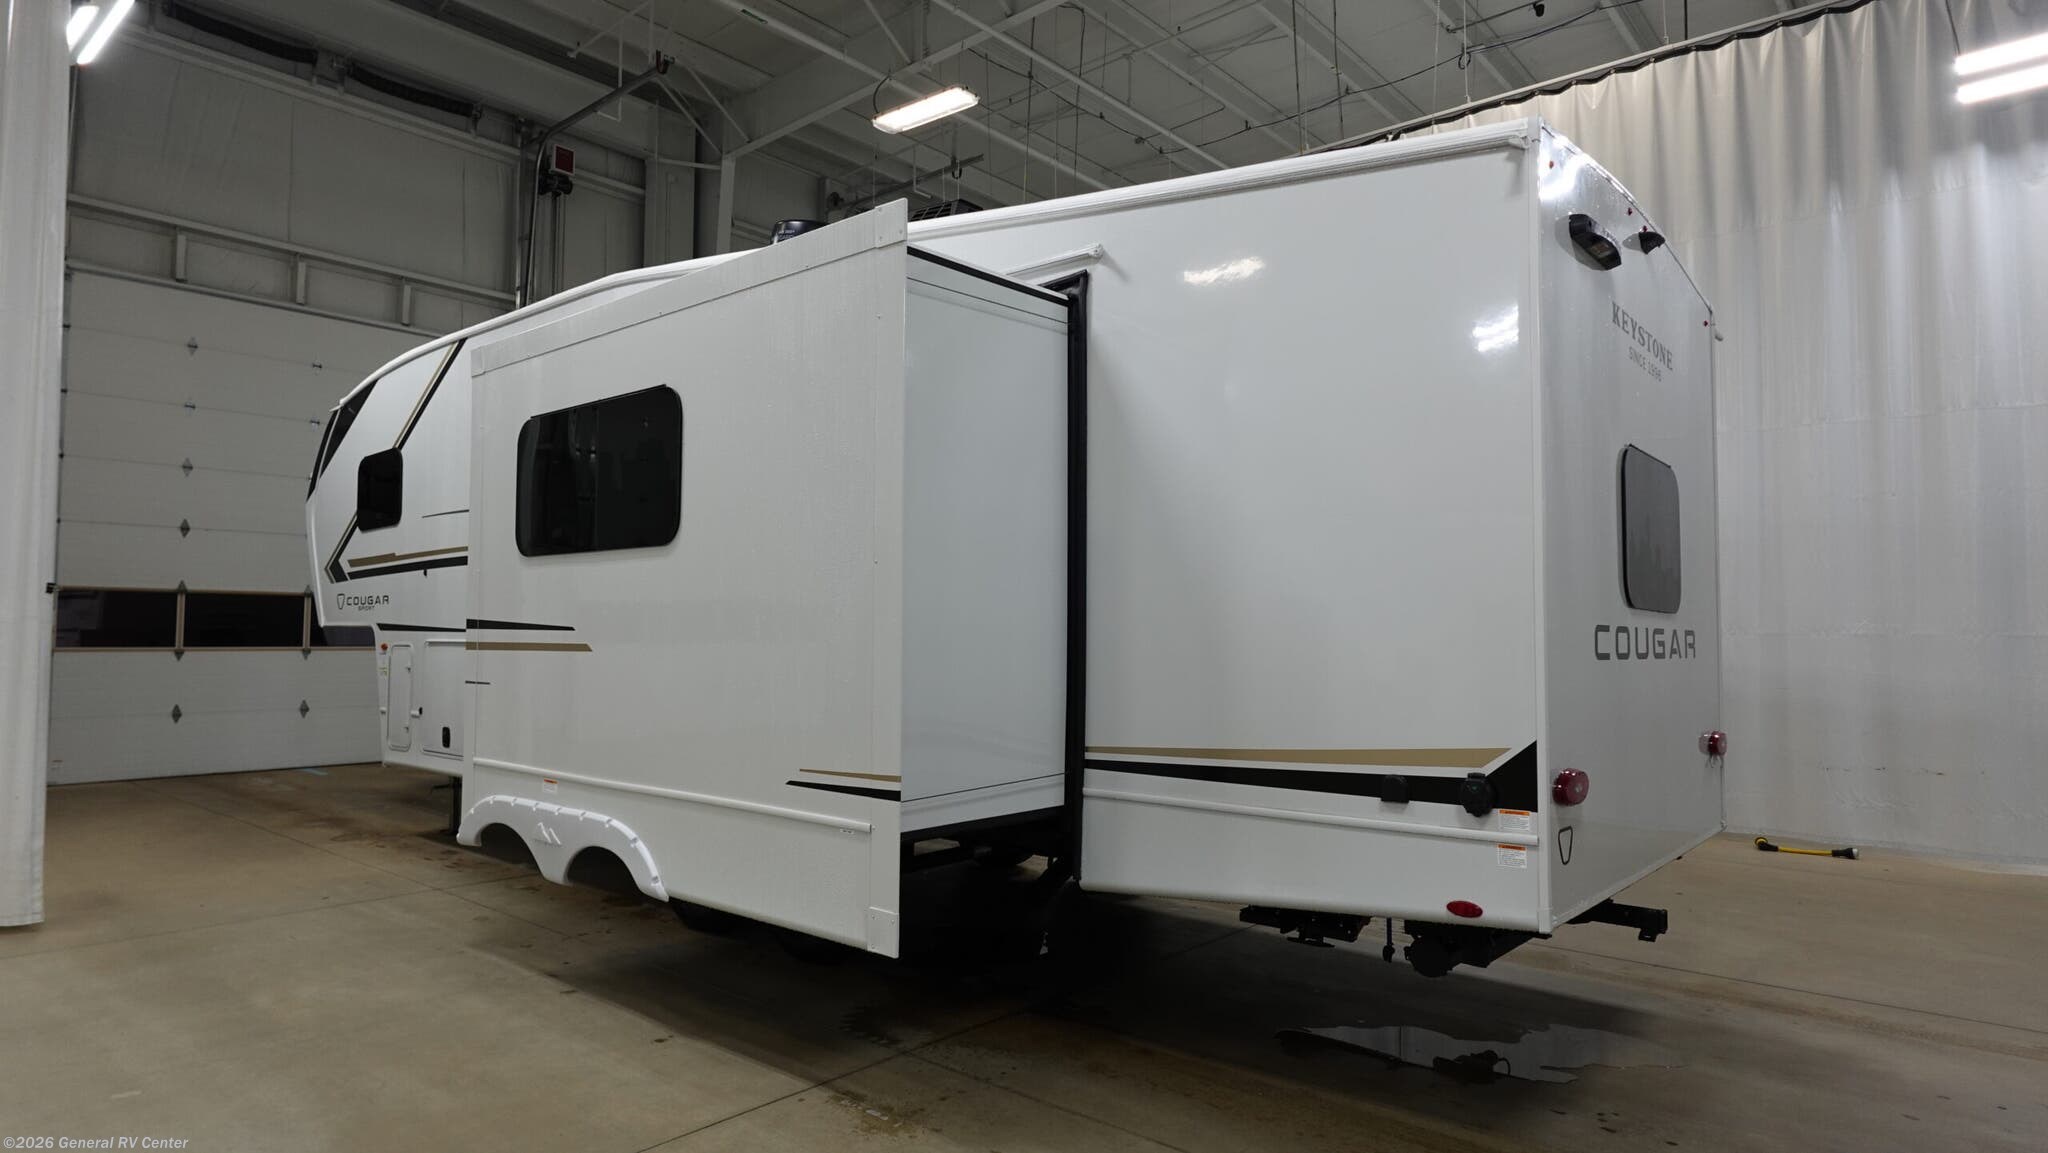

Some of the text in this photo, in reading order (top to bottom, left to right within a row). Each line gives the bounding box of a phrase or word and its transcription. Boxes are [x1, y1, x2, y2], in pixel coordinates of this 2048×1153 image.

[1611, 300, 1673, 371] KEYSTONE
[1628, 346, 1647, 371] SINCE
[346, 595, 390, 605] COUGAR
[1594, 624, 1696, 661] COUGAR
